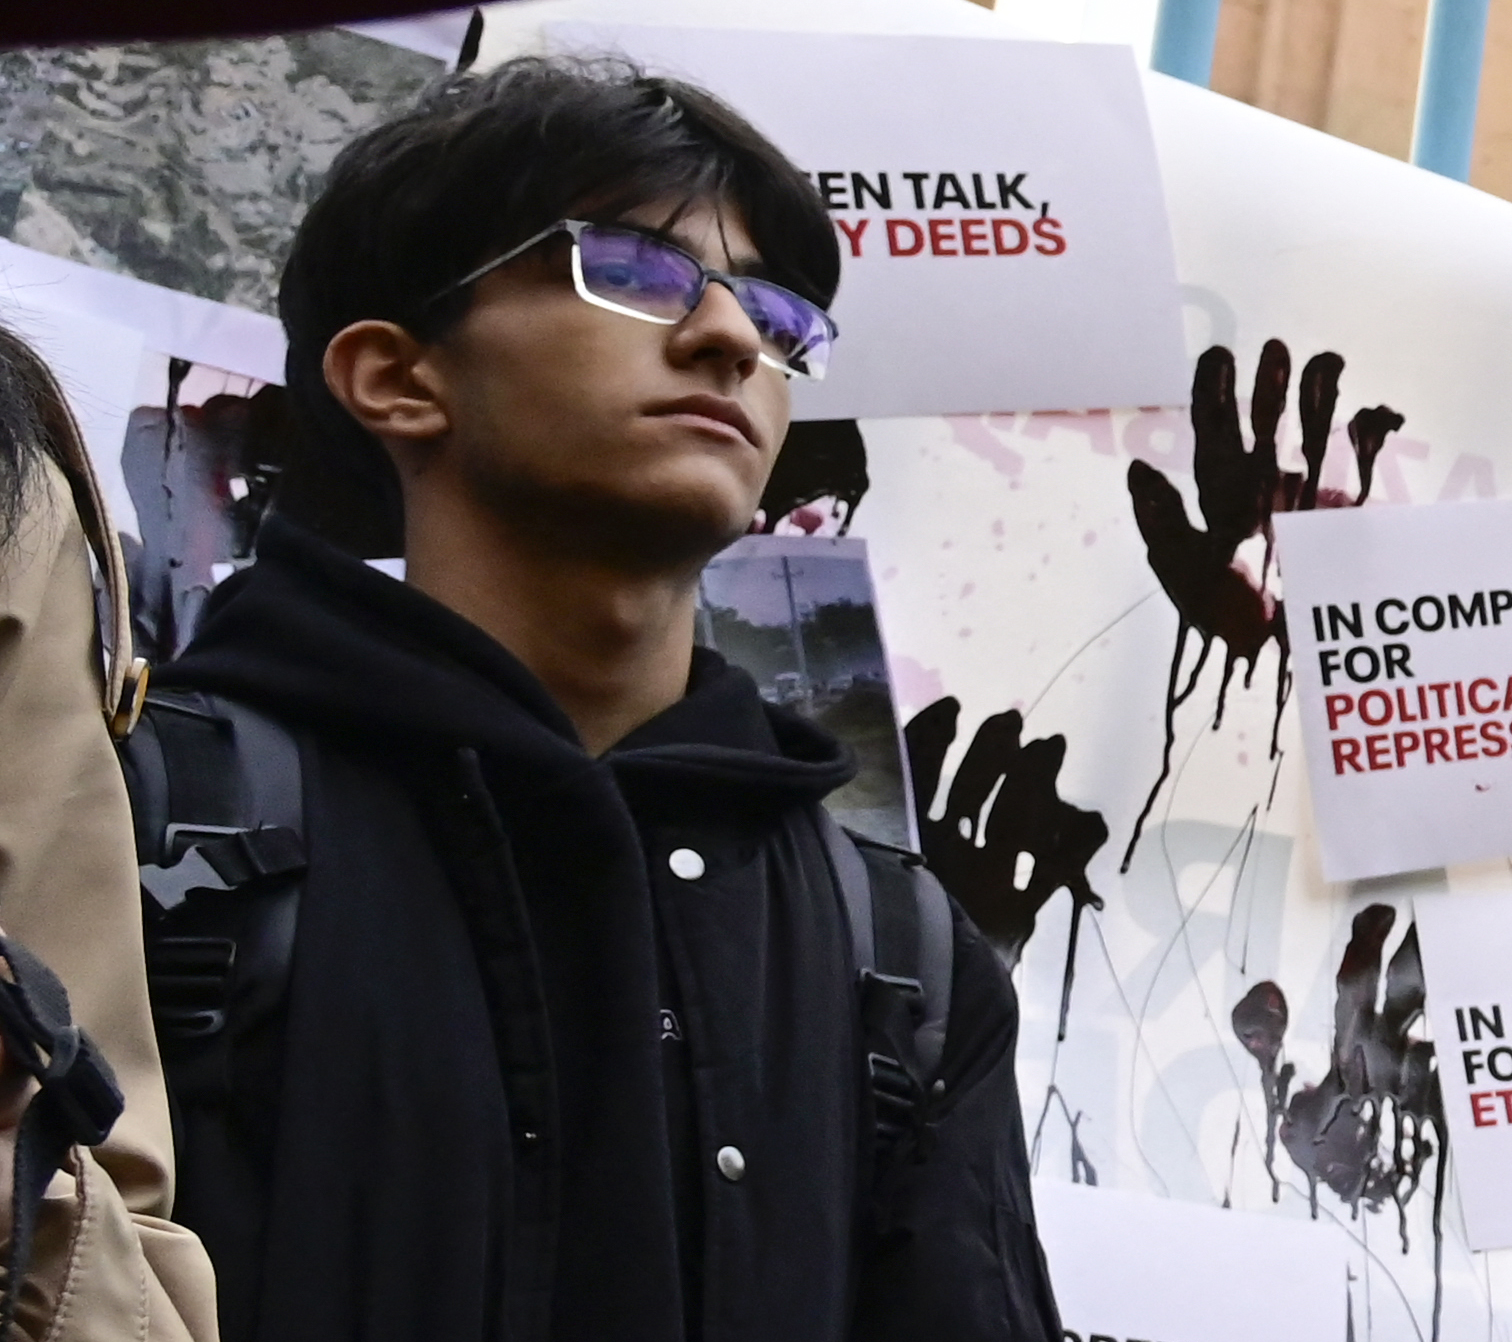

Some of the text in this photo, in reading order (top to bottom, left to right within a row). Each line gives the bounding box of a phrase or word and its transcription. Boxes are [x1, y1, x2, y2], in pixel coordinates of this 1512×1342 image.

[805, 172, 1050, 218] EN TALK,
[885, 218, 1067, 257] DEEDS
[1312, 603, 1364, 642] IN
[1319, 643, 1414, 687] FOR
[1455, 1004, 1505, 1041] IN
